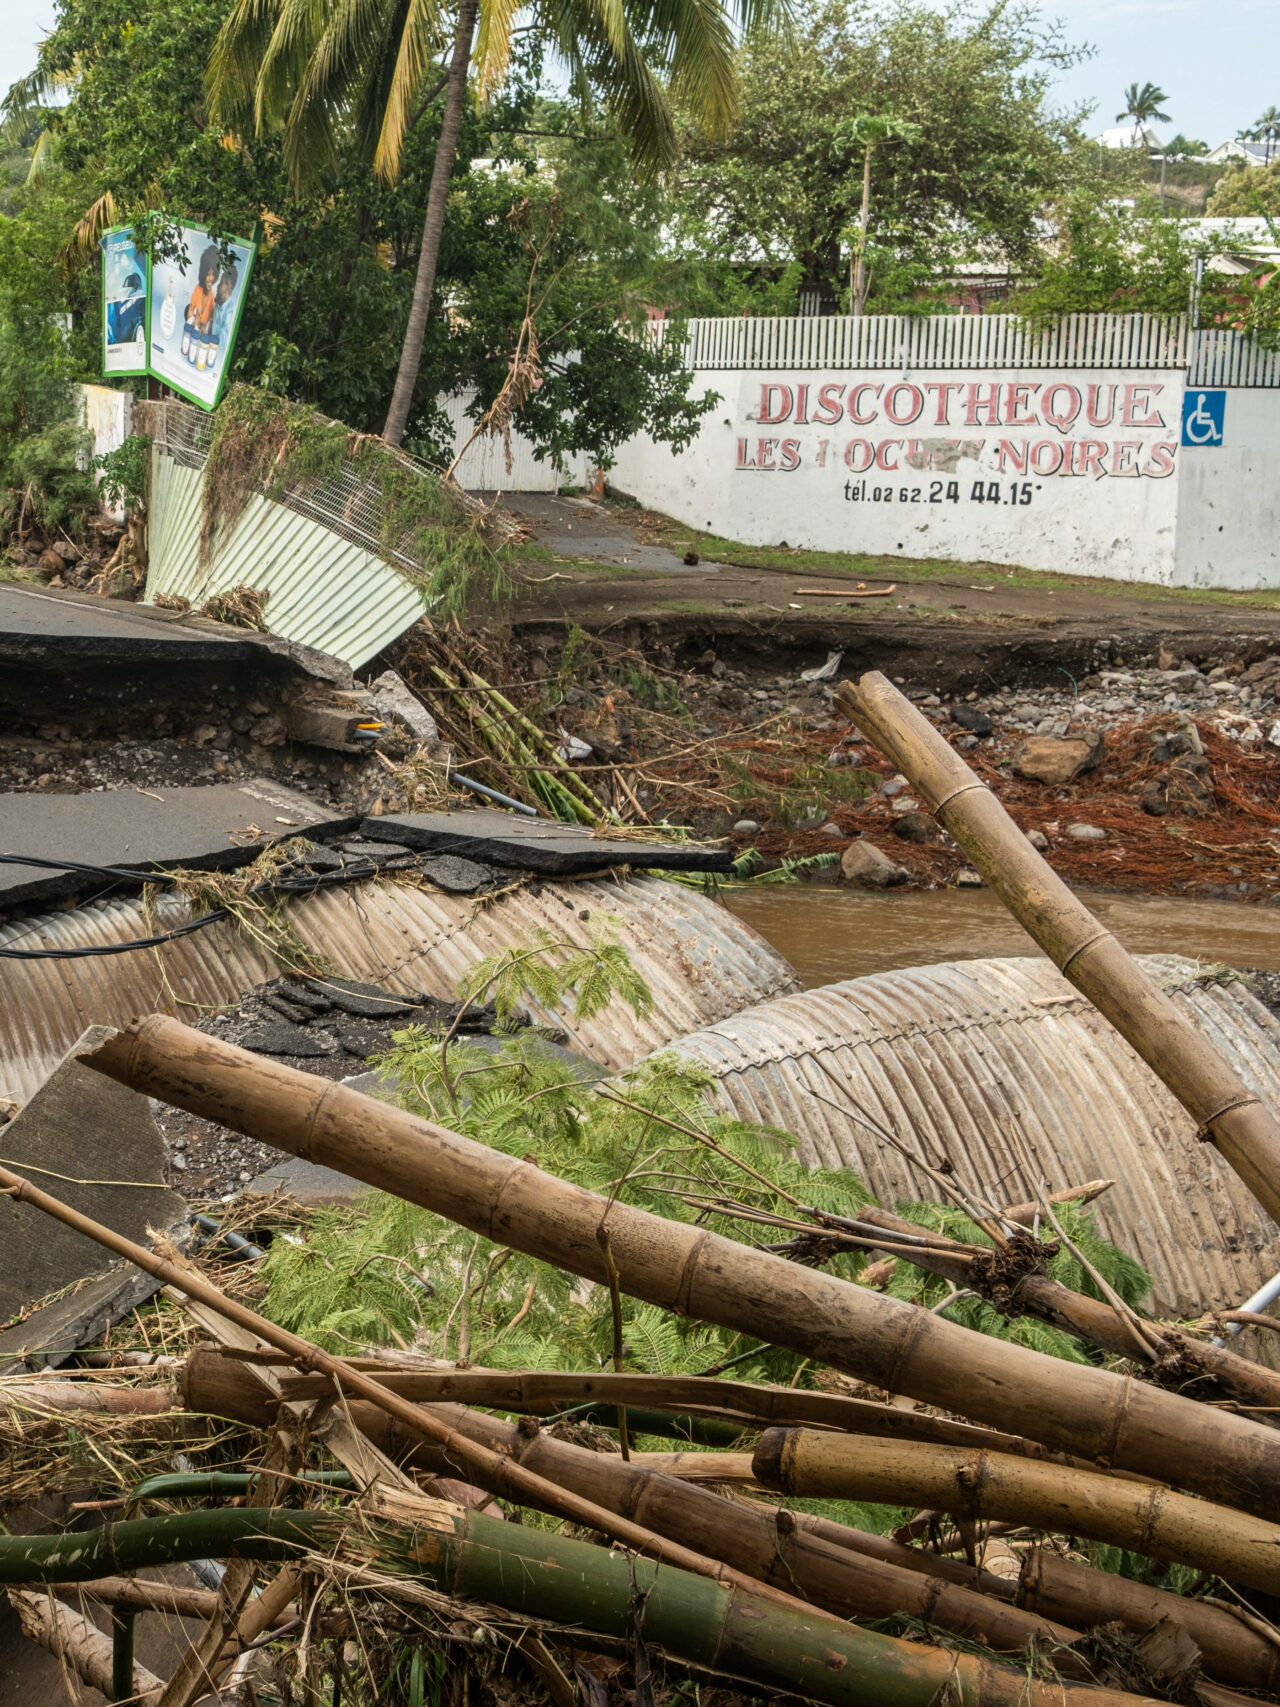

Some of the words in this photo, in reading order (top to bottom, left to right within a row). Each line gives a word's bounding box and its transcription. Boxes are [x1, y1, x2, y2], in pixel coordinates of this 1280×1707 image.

[756, 382, 1166, 434] DISCOTHEQUE
[735, 437, 802, 471] LES
[997, 439, 1178, 481] NOIRES
[970, 482, 1033, 506] 44.15
